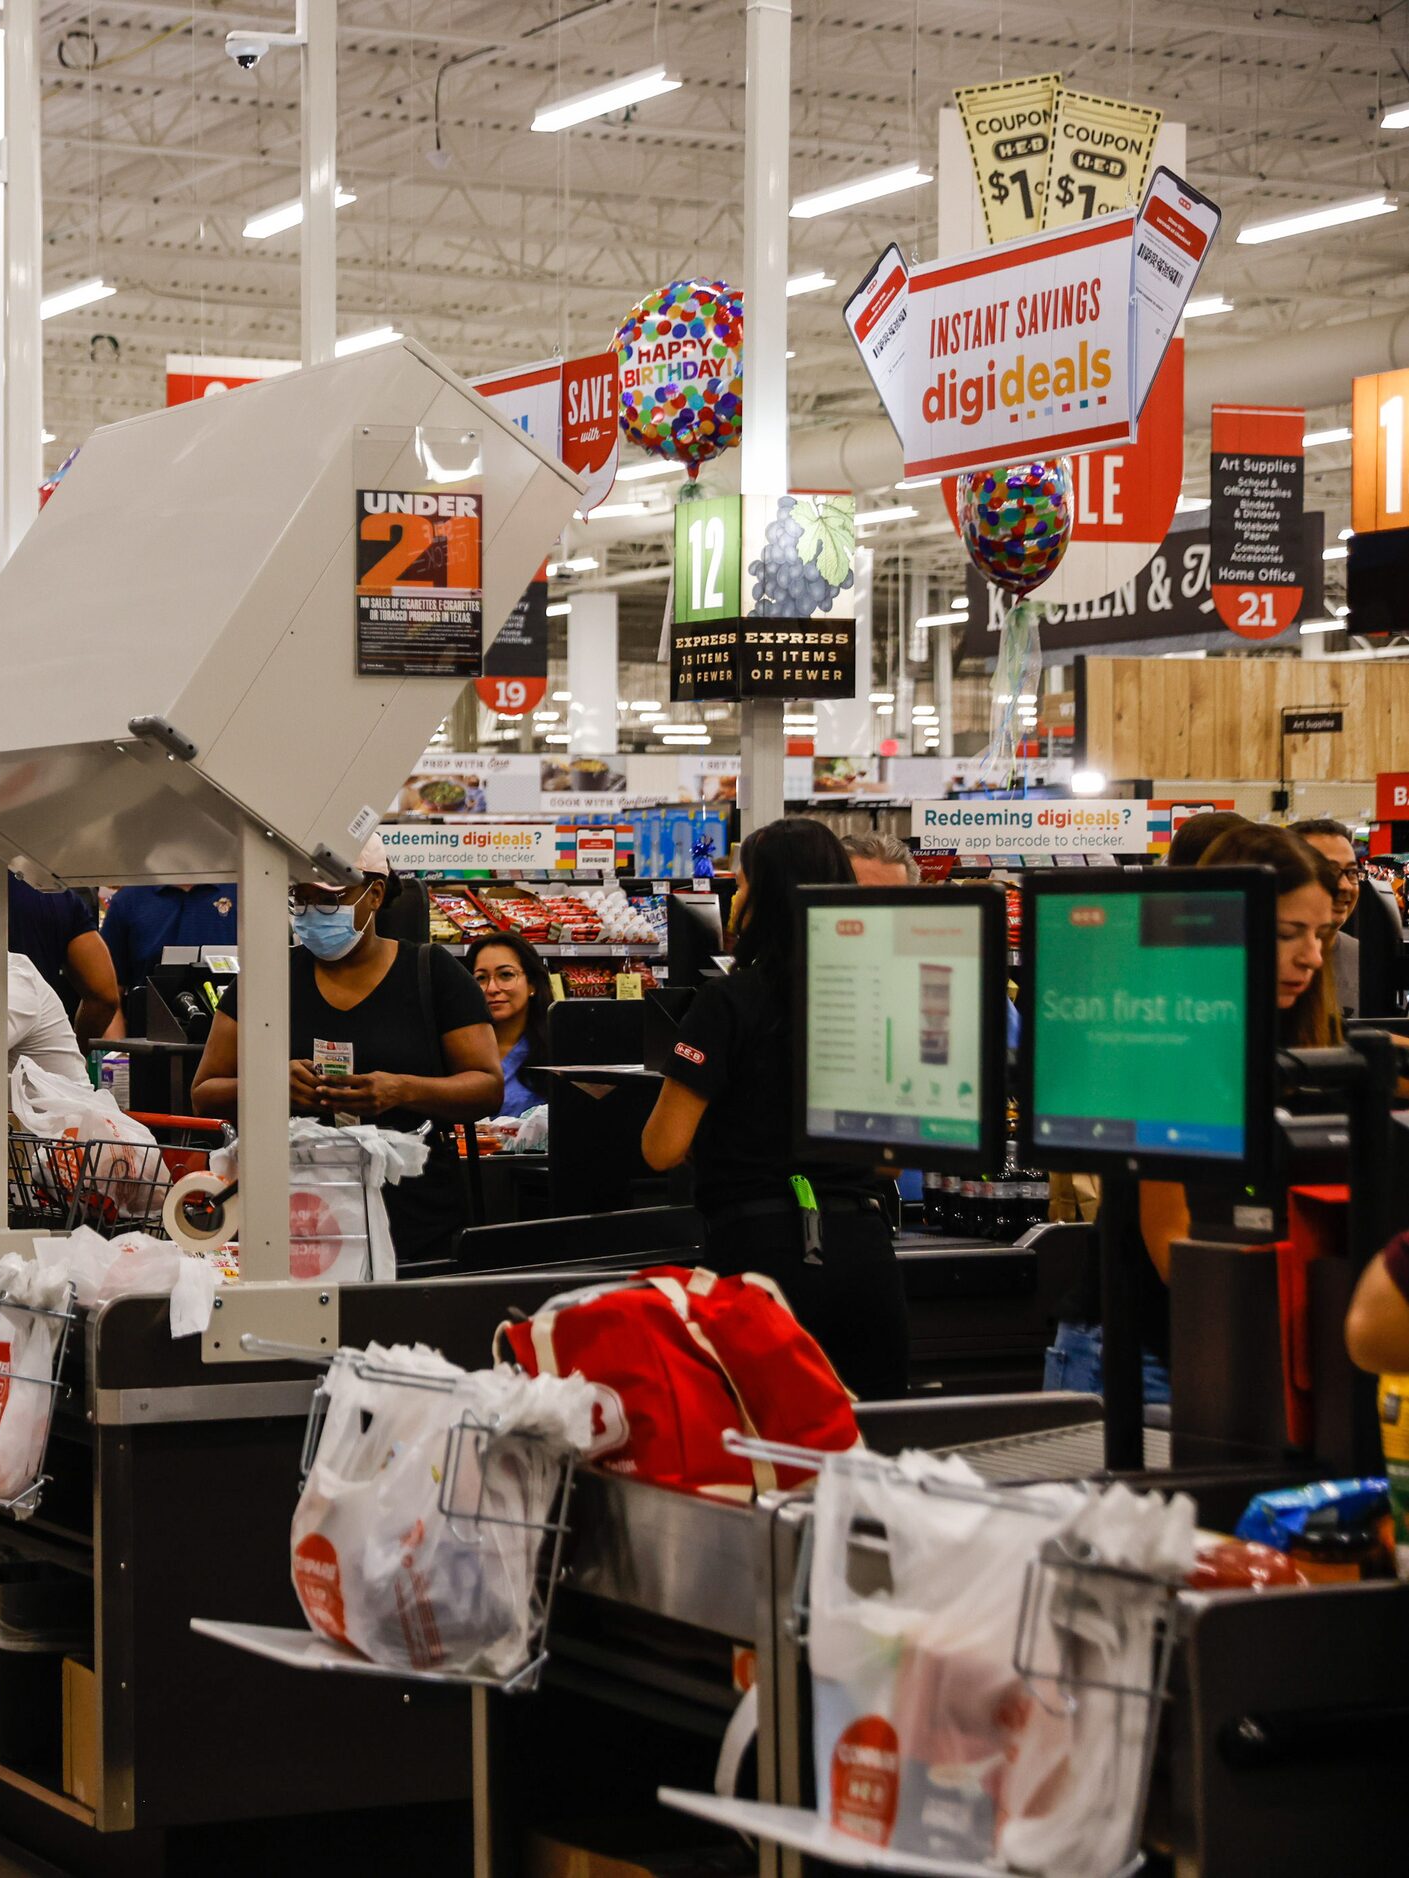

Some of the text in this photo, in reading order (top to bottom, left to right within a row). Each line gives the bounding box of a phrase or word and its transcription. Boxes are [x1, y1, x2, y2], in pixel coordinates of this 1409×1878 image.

[975, 109, 1052, 135] COUPON
[1063, 123, 1143, 156] COUPON
[929, 300, 1009, 359] INSTANT
[1016, 278, 1101, 338] SAVINGS
[638, 338, 713, 364] HAPPY
[624, 357, 733, 389] BIRTHDAY!
[922, 340, 1112, 425] digideals
[567, 373, 613, 426] SAVE
[580, 427, 601, 443] with
[1220, 458, 1297, 474] Art Supplies
[1238, 477, 1270, 488] School
[1223, 486, 1292, 498] Office Supplies
[363, 492, 479, 518] UNDER
[1239, 499, 1275, 510] Binders
[1242, 509, 1280, 520] Dividers
[1234, 521, 1280, 532] Notebook
[1243, 531, 1270, 541] Paper
[360, 512, 480, 589] 21
[1234, 543, 1280, 554] Computer
[688, 516, 725, 610] 12
[1230, 553, 1284, 563] Accessories
[1218, 567, 1296, 582] Home Office
[1147, 556, 1174, 613] &
[359, 597, 369, 609] NO
[370, 597, 391, 609] SALES
[391, 598, 399, 609] OF
[1237, 592, 1277, 627] 21
[369, 609, 379, 620] OR
[379, 610, 407, 621] TOBACCO
[409, 610, 441, 622] PRODUCTS
[441, 611, 449, 622] IN
[675, 632, 737, 649] EXPRESS
[745, 632, 849, 644] EXPRESS
[682, 651, 730, 666] 15 ITEMS
[756, 651, 837, 662] 15 ITEMS
[679, 670, 733, 684] OR FEWER
[751, 669, 843, 681] OR FEWER
[495, 681, 527, 708] 19
[1293, 719, 1335, 729] Art Supplies
[455, 758, 484, 769] WITH
[584, 797, 614, 807] WITH
[924, 809, 1033, 828] Redeeming
[380, 830, 459, 848] edeeming
[923, 834, 1125, 849] Show app barcode to checker.
[403, 854, 425, 865] app
[428, 852, 474, 863] barcode
[477, 852, 488, 863] to
[491, 852, 536, 863] checker.
[1043, 989, 1237, 1024] Scan first item
